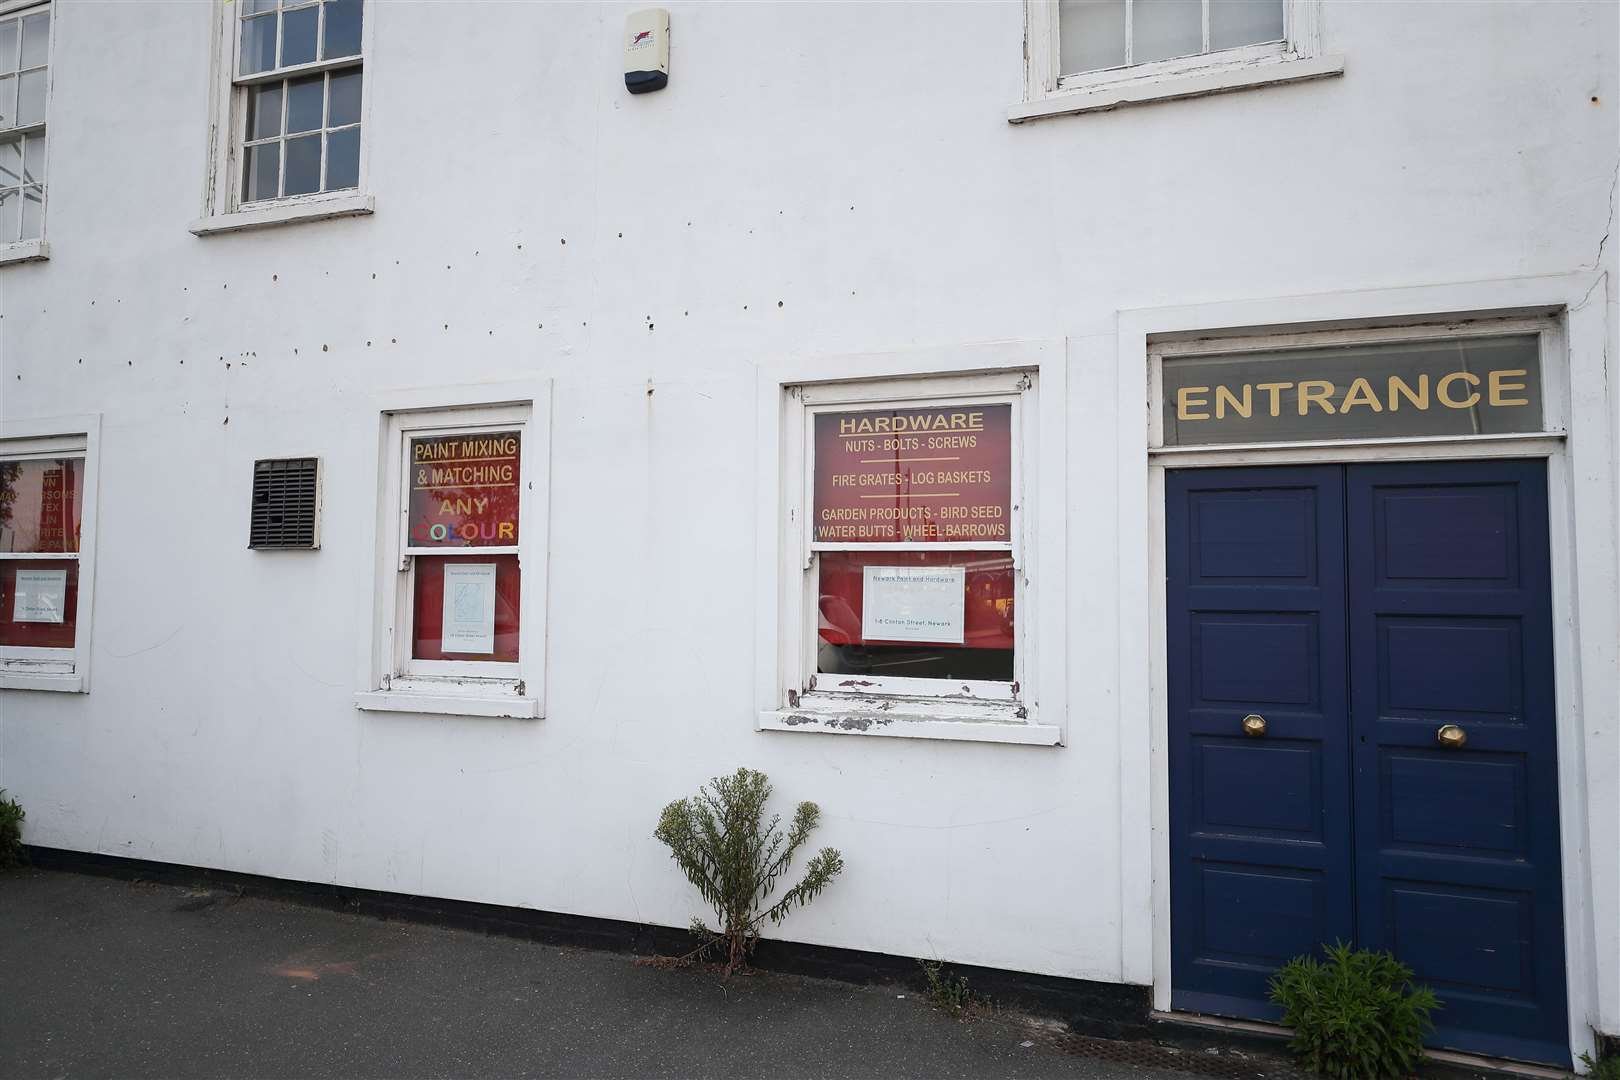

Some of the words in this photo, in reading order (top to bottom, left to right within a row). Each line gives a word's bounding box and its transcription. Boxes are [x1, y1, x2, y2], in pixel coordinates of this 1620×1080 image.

[1177, 369, 1529, 421] ENTRANCE
[840, 413, 984, 433] HARDWARE
[415, 442, 459, 459] PAINT
[462, 438, 517, 457] MIXING
[845, 440, 875, 452] NUTS
[883, 438, 919, 451] BOLTS
[928, 435, 977, 449] SCREWS
[417, 469, 428, 485] &
[432, 465, 513, 484] MATCHING
[832, 474, 856, 486] FIRE
[858, 473, 902, 486] GRATES
[911, 472, 935, 485] LOG
[937, 471, 991, 484] BASKETS
[439, 498, 489, 515] ANY
[821, 508, 867, 520] GARDEN
[869, 507, 931, 520] PRODUCTS
[940, 506, 967, 519] BIRD
[971, 506, 1002, 518] SEED
[413, 522, 514, 541] COLOUR
[819, 525, 856, 537] WATER
[859, 525, 894, 537] BUTTS
[903, 525, 943, 537] WHEEL
[946, 524, 1006, 536] BARROWS
[926, 576, 955, 584] Hardware
